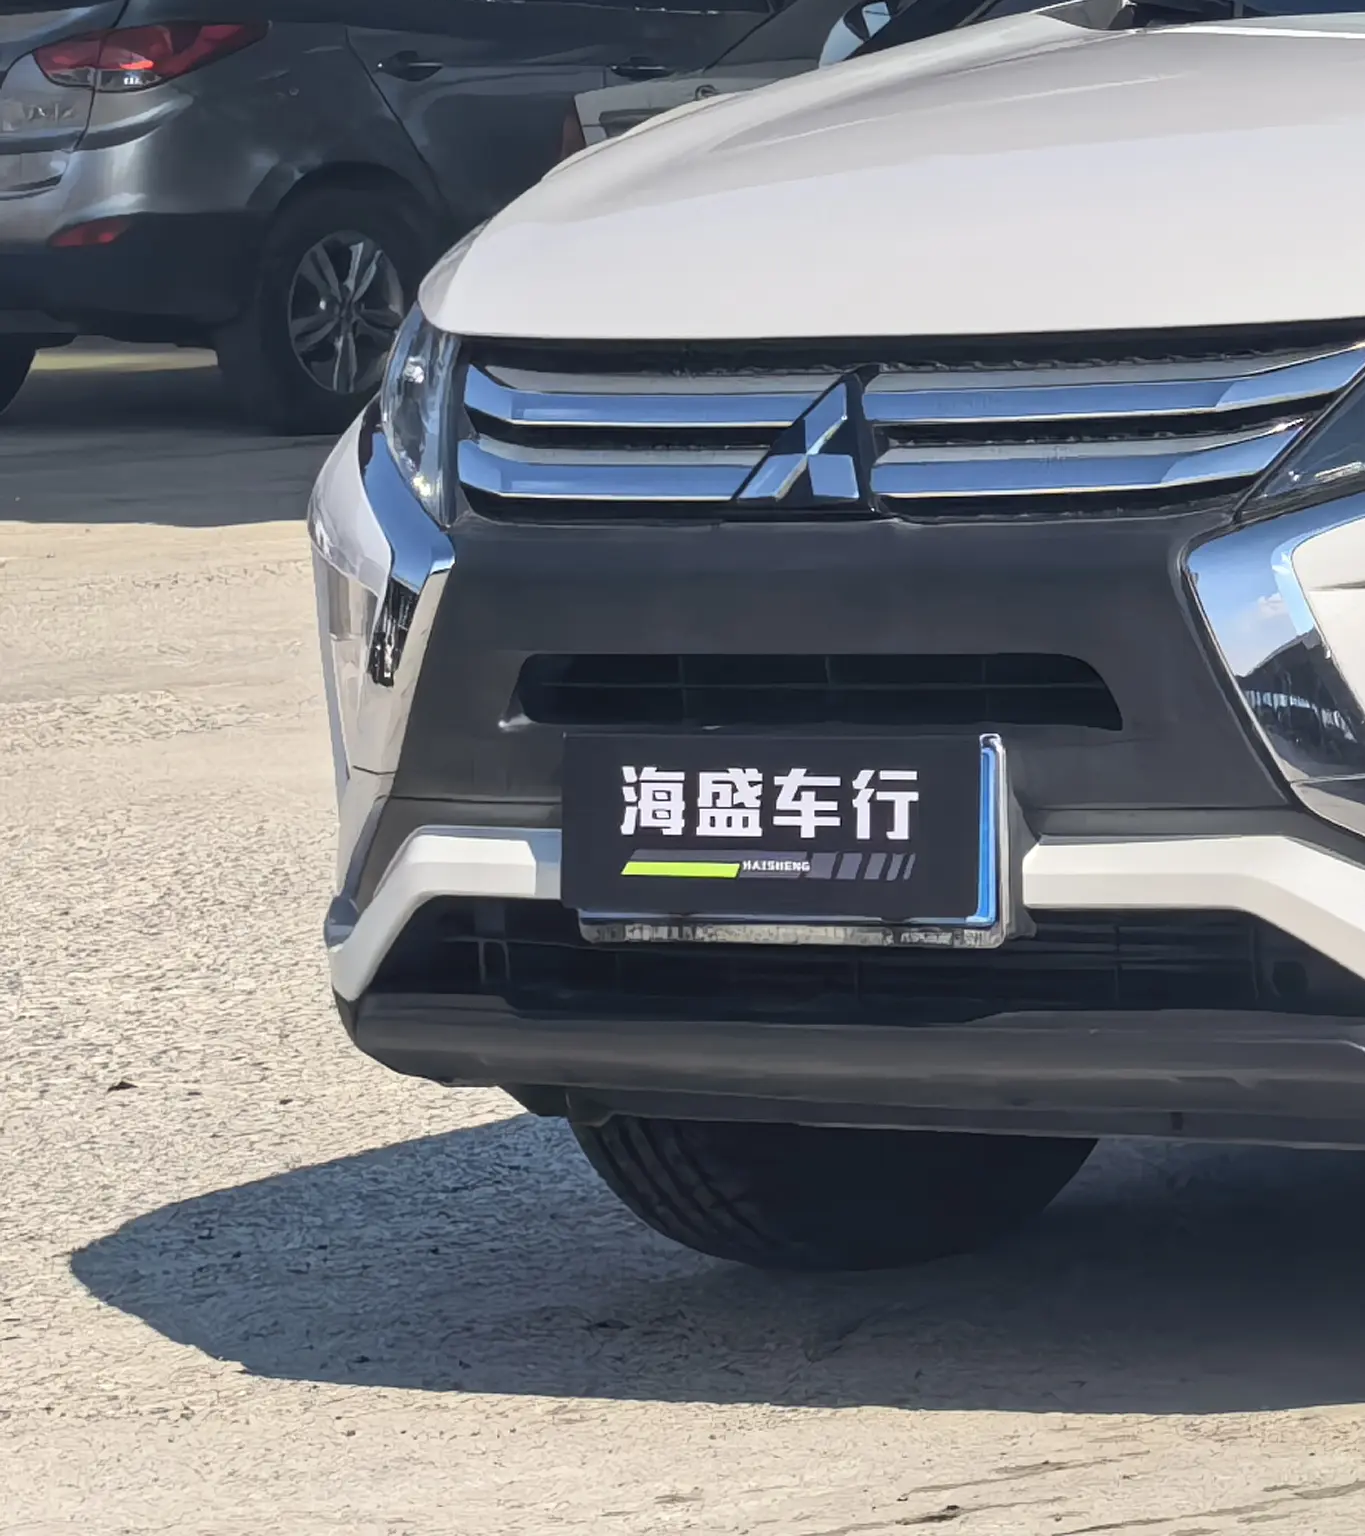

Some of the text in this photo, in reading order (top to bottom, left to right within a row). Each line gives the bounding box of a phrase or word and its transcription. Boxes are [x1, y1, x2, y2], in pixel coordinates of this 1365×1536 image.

[620, 766, 919, 839] 海盛车行
[742, 860, 810, 872] HAISHENG
